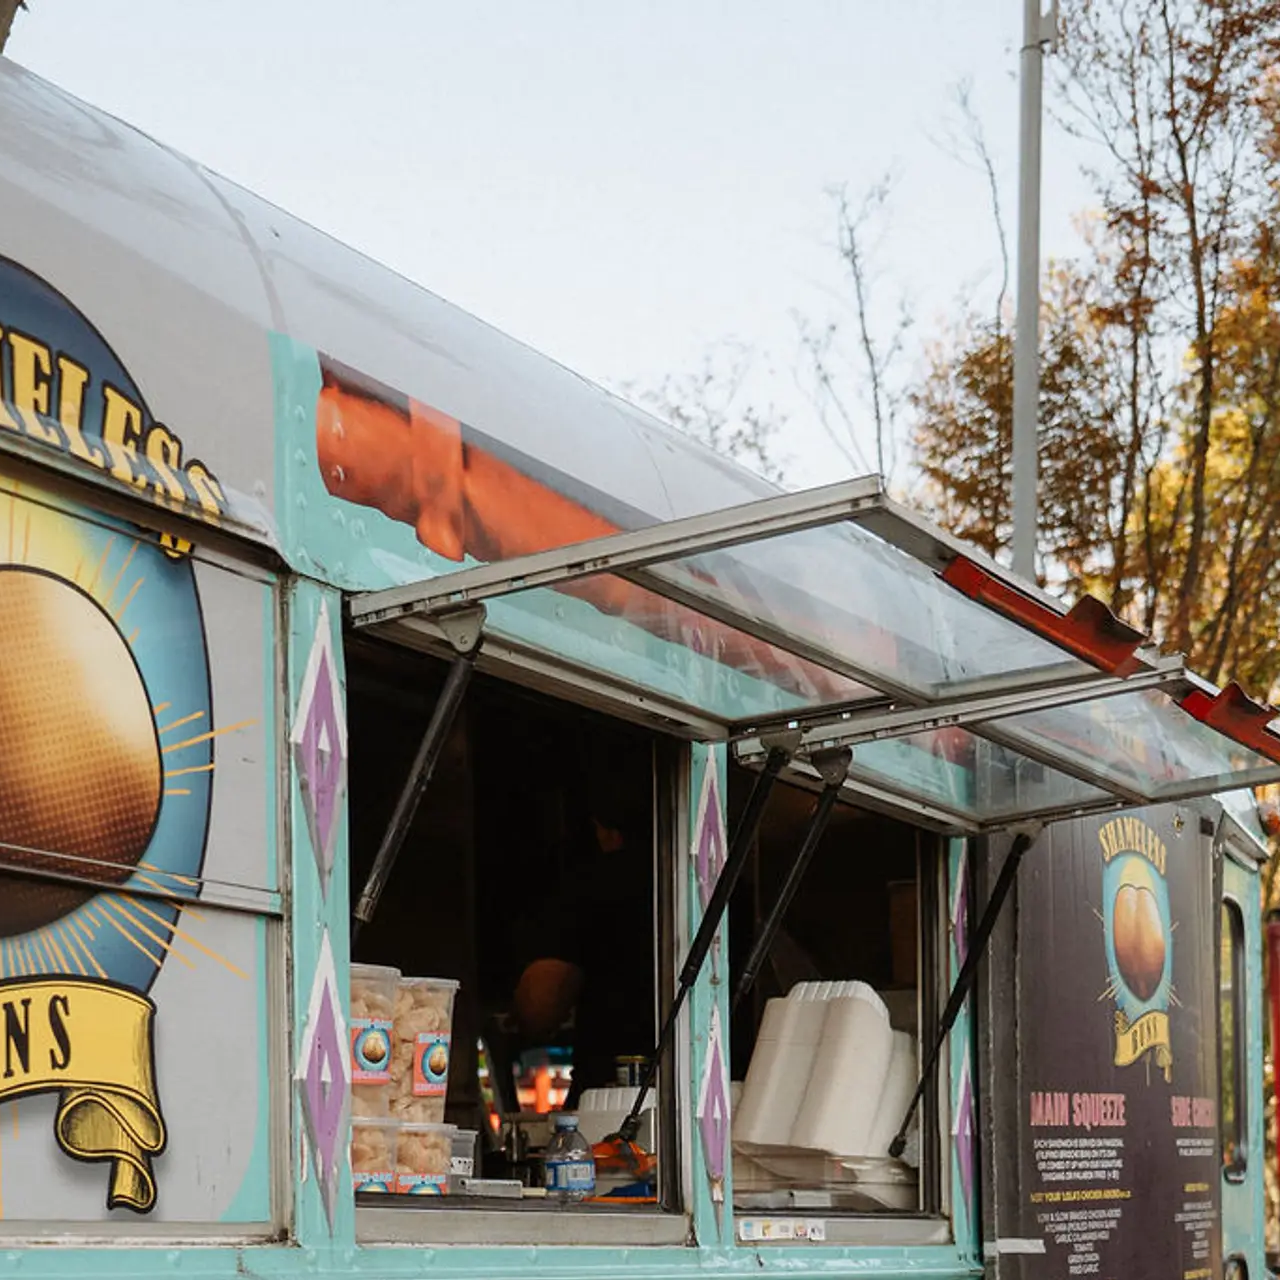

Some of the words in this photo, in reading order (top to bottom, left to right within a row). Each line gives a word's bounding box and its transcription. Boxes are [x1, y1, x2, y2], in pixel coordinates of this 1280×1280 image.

[1098, 816, 1166, 876] SHAMELESS
[1030, 1092, 1069, 1126] MAIN
[1072, 1092, 1127, 1131] SQUEEZE
